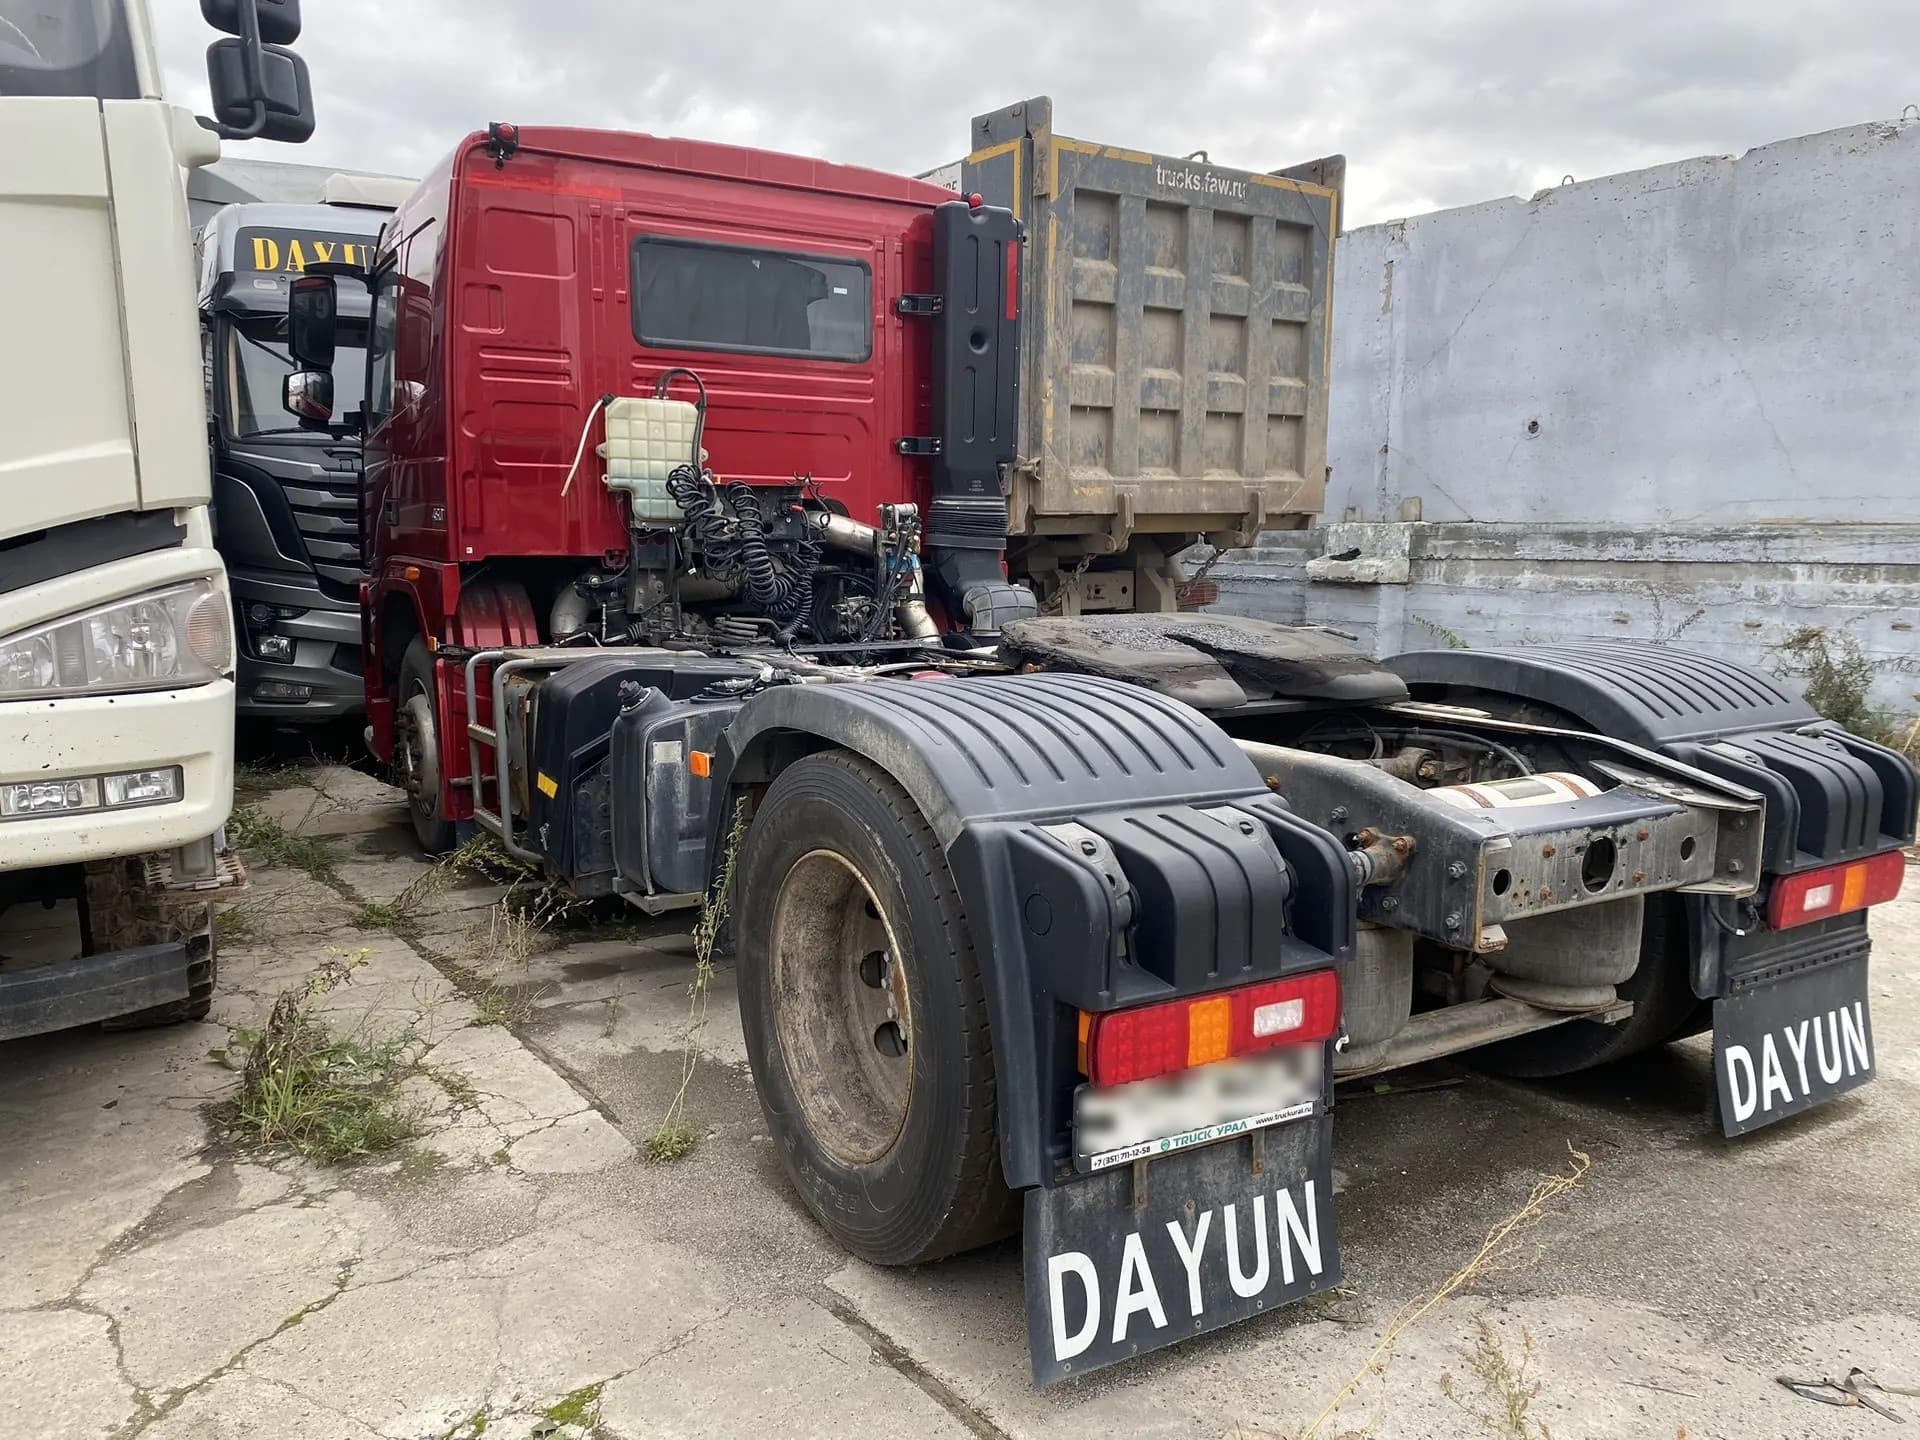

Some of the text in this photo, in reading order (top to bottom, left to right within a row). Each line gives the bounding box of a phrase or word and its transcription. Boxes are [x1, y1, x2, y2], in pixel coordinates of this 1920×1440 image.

[1156, 164, 1247, 199] trucks.faw.ru
[251, 237, 377, 274] DAYU
[1725, 1002, 1870, 1122] DAYUN
[1173, 1121, 1248, 1147] TRUCK УРАЛ
[1048, 1180, 1323, 1362] DAYUN
